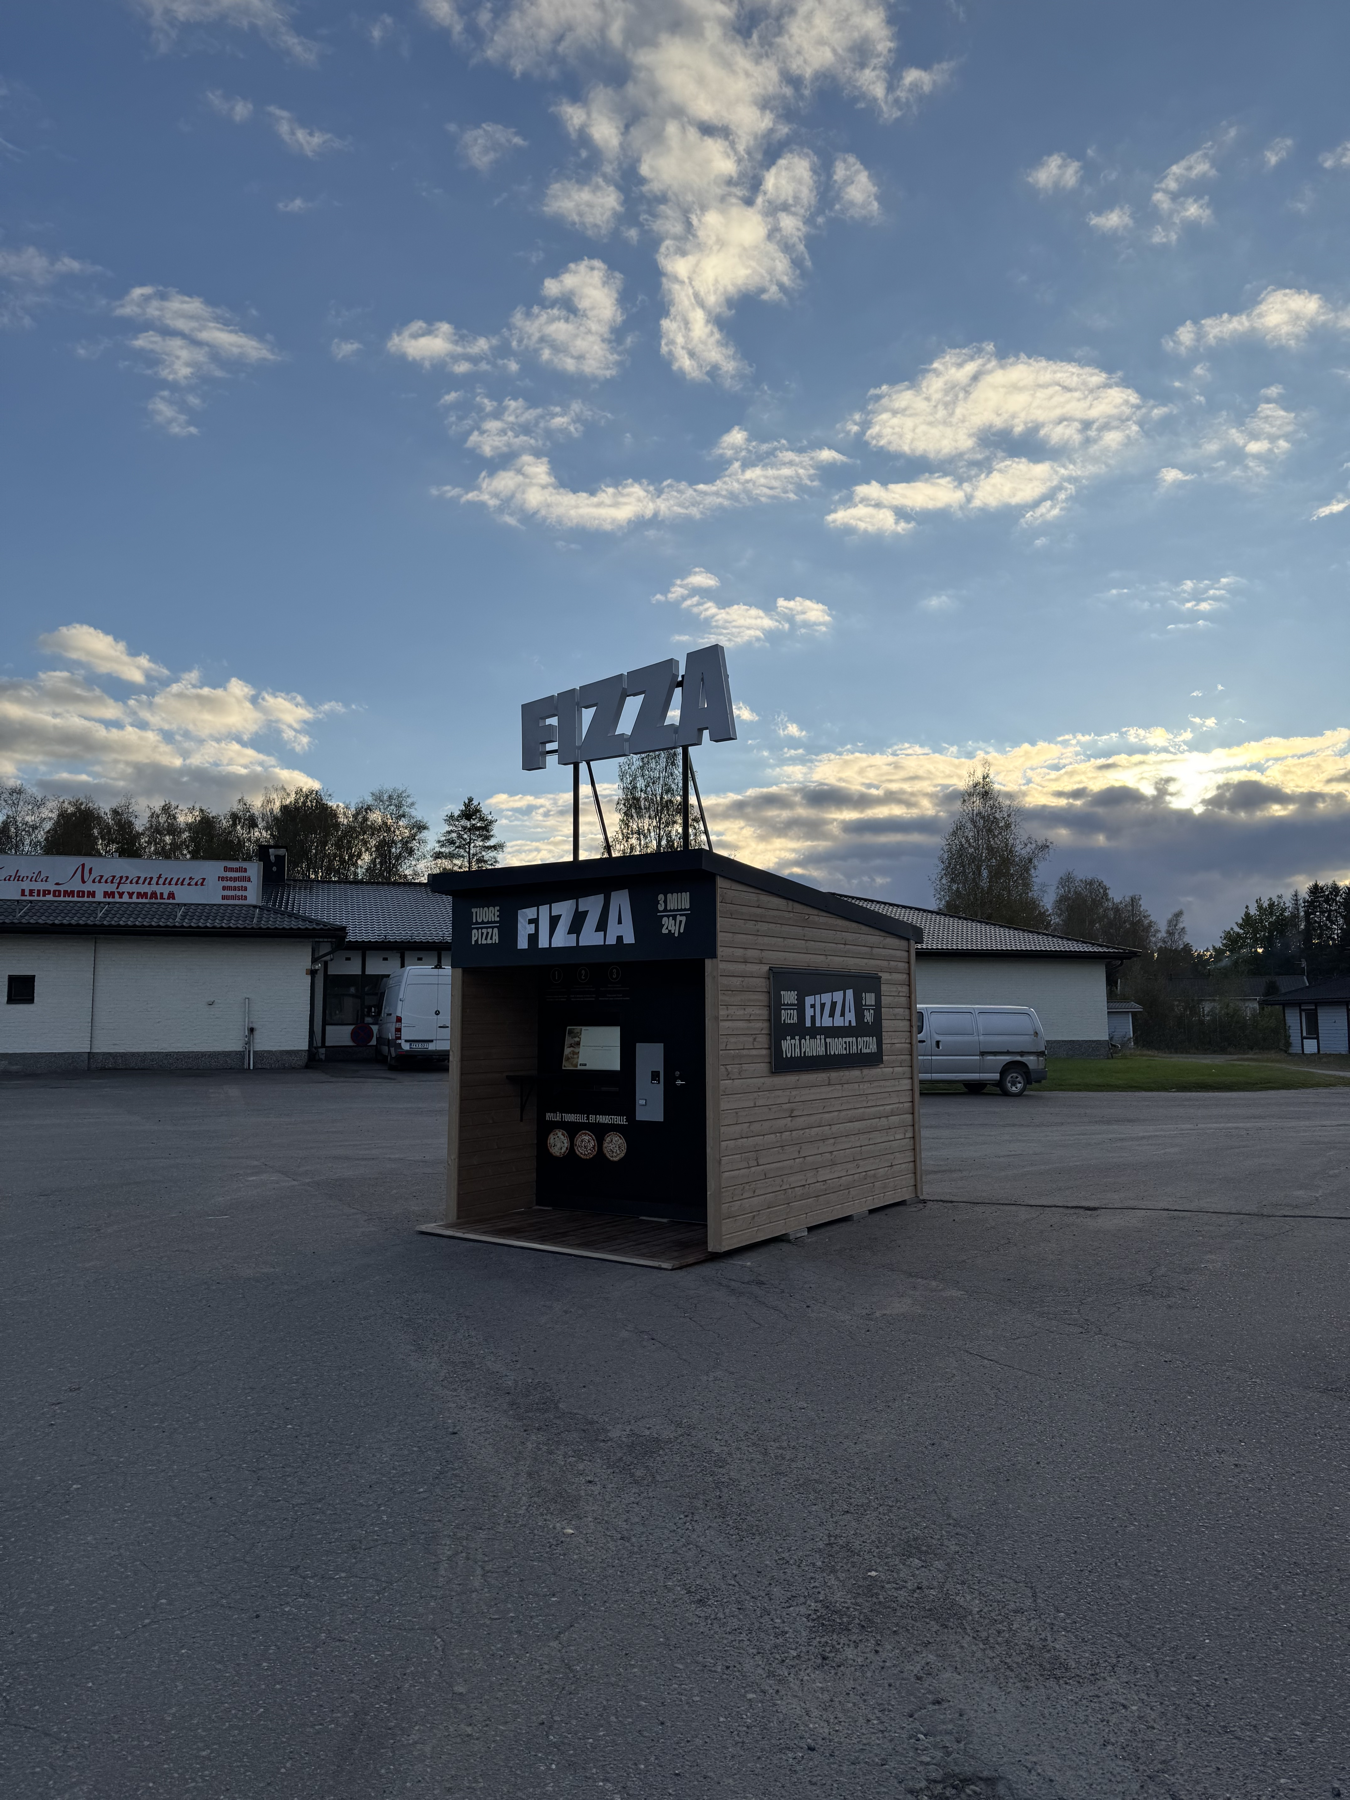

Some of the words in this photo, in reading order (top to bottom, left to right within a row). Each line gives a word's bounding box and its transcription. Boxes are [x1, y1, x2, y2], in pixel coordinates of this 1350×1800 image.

[521, 644, 737, 771] FIZZA
[54, 863, 207, 889] Naapantuura
[223, 865, 248, 873] Omalla
[20, 888, 96, 899] LEIPOMON
[103, 888, 176, 901] MYYMÄLÄ
[657, 893, 665, 911] 3
[666, 892, 690, 911] MIN
[471, 906, 500, 923] TUORE
[517, 889, 636, 950] FIZZA
[661, 915, 686, 937] 24/7
[471, 928, 499, 945] PIZZA
[580, 969, 586, 980] 2
[612, 968, 618, 979] 3
[780, 991, 798, 1004] TUORE
[862, 992, 866, 1005] 3
[781, 1010, 798, 1023] PIZZA
[804, 988, 857, 1028] FIZZA
[864, 1009, 875, 1025] 24/7
[781, 1036, 801, 1059] YÖTÄ
[801, 1035, 826, 1057] PÄIVÄÄ
[826, 1037, 857, 1056] TUORETTA
[857, 1036, 878, 1054] PIZZAA
